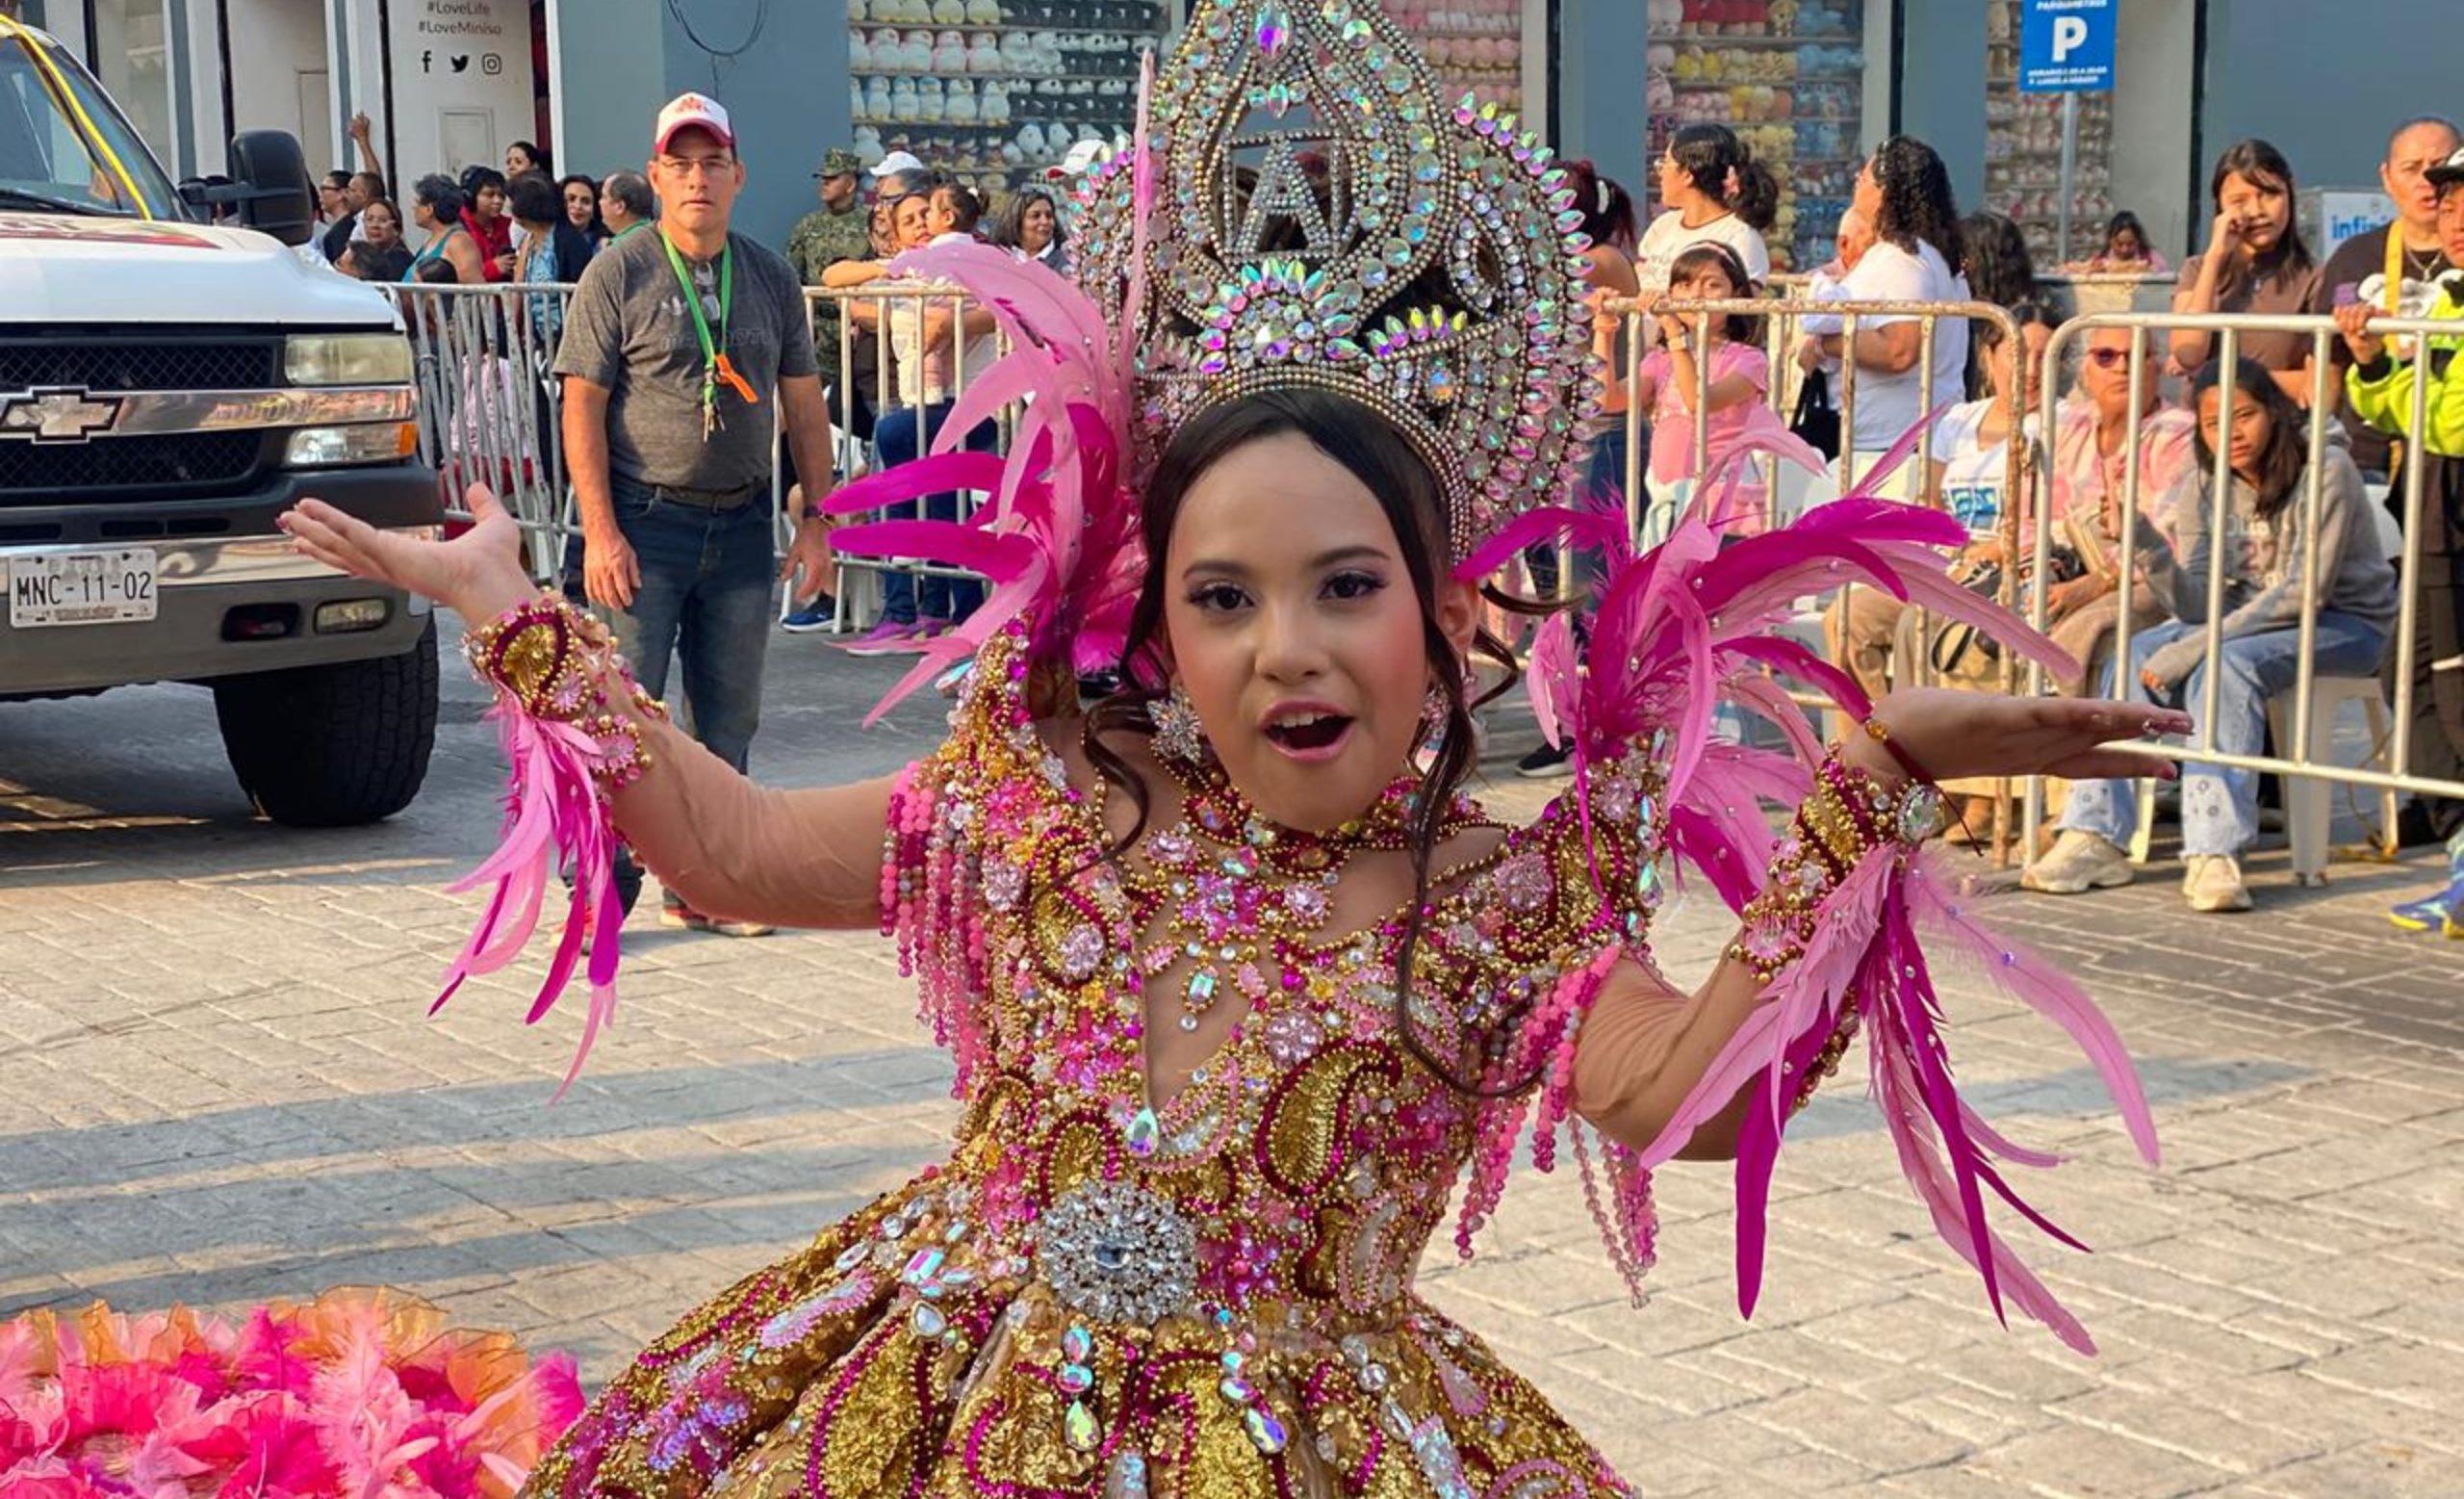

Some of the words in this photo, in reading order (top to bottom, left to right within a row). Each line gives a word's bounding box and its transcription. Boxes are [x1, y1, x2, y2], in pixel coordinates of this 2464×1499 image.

[427, 1, 491, 14] #LoveLife
[419, 19, 501, 35] #LoveMiniso
[2052, 15, 2088, 63] P
[15, 571, 152, 607] MNC-11-02
